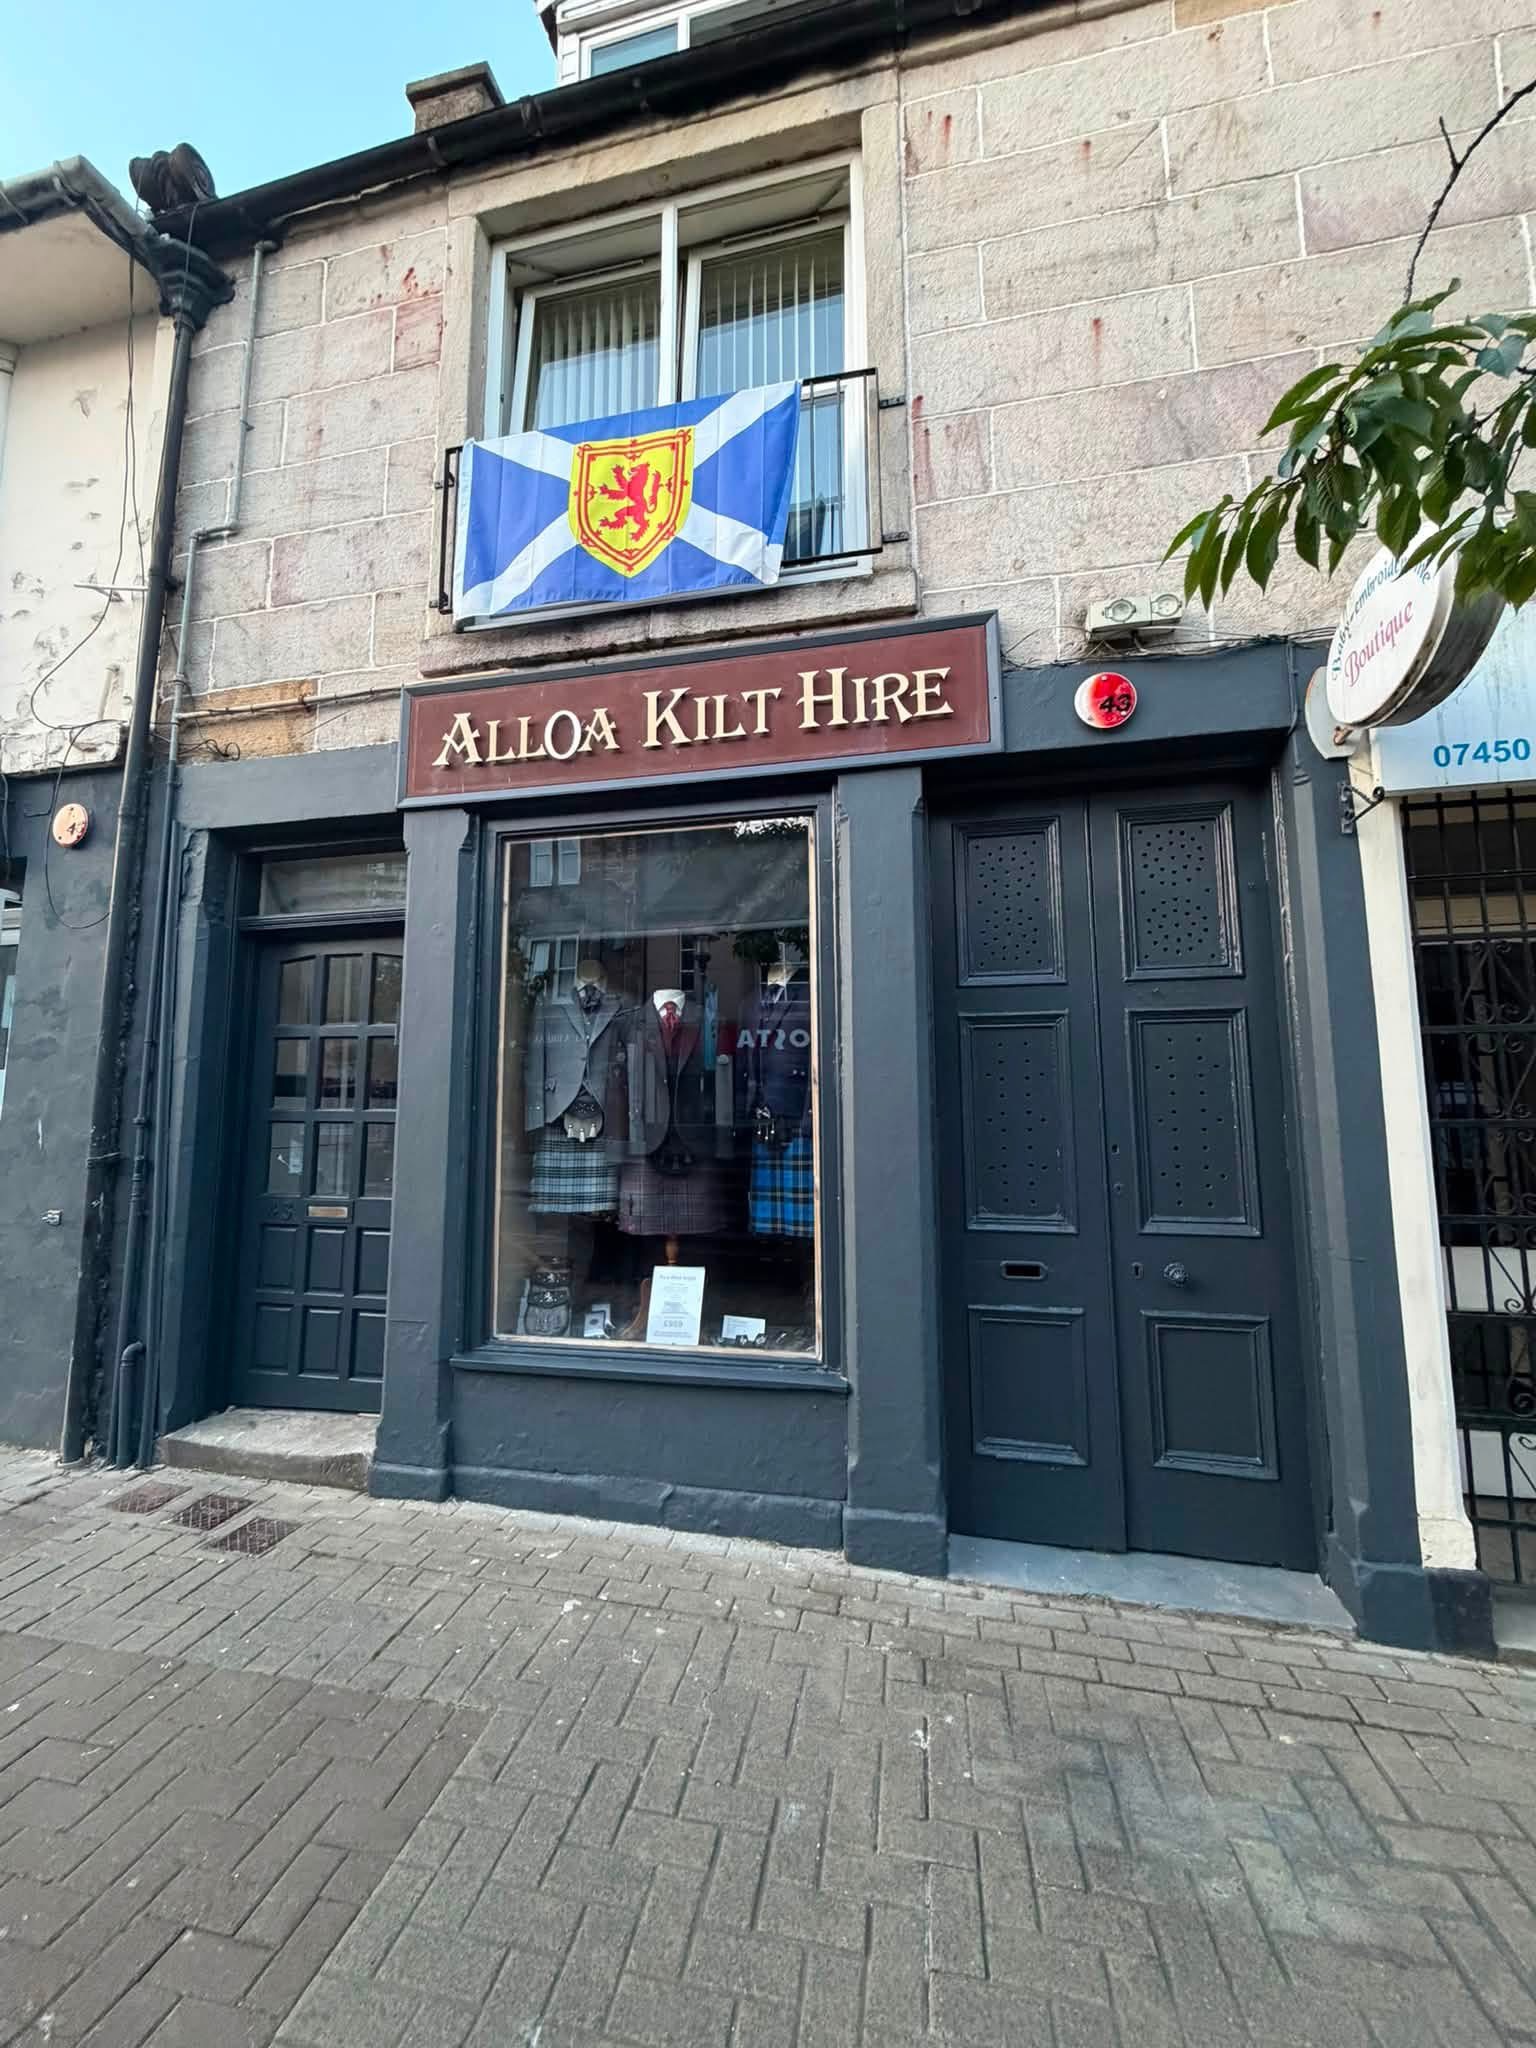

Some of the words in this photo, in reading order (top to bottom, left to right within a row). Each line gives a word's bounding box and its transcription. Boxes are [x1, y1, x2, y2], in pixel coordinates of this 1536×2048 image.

[1344, 600, 1414, 687] Boutique
[432, 706, 621, 767] ALLOA
[641, 686, 783, 749] KILT
[796, 665, 955, 729] HIRE
[1099, 693, 1132, 713] 43
[1433, 738, 1531, 768] 07450
